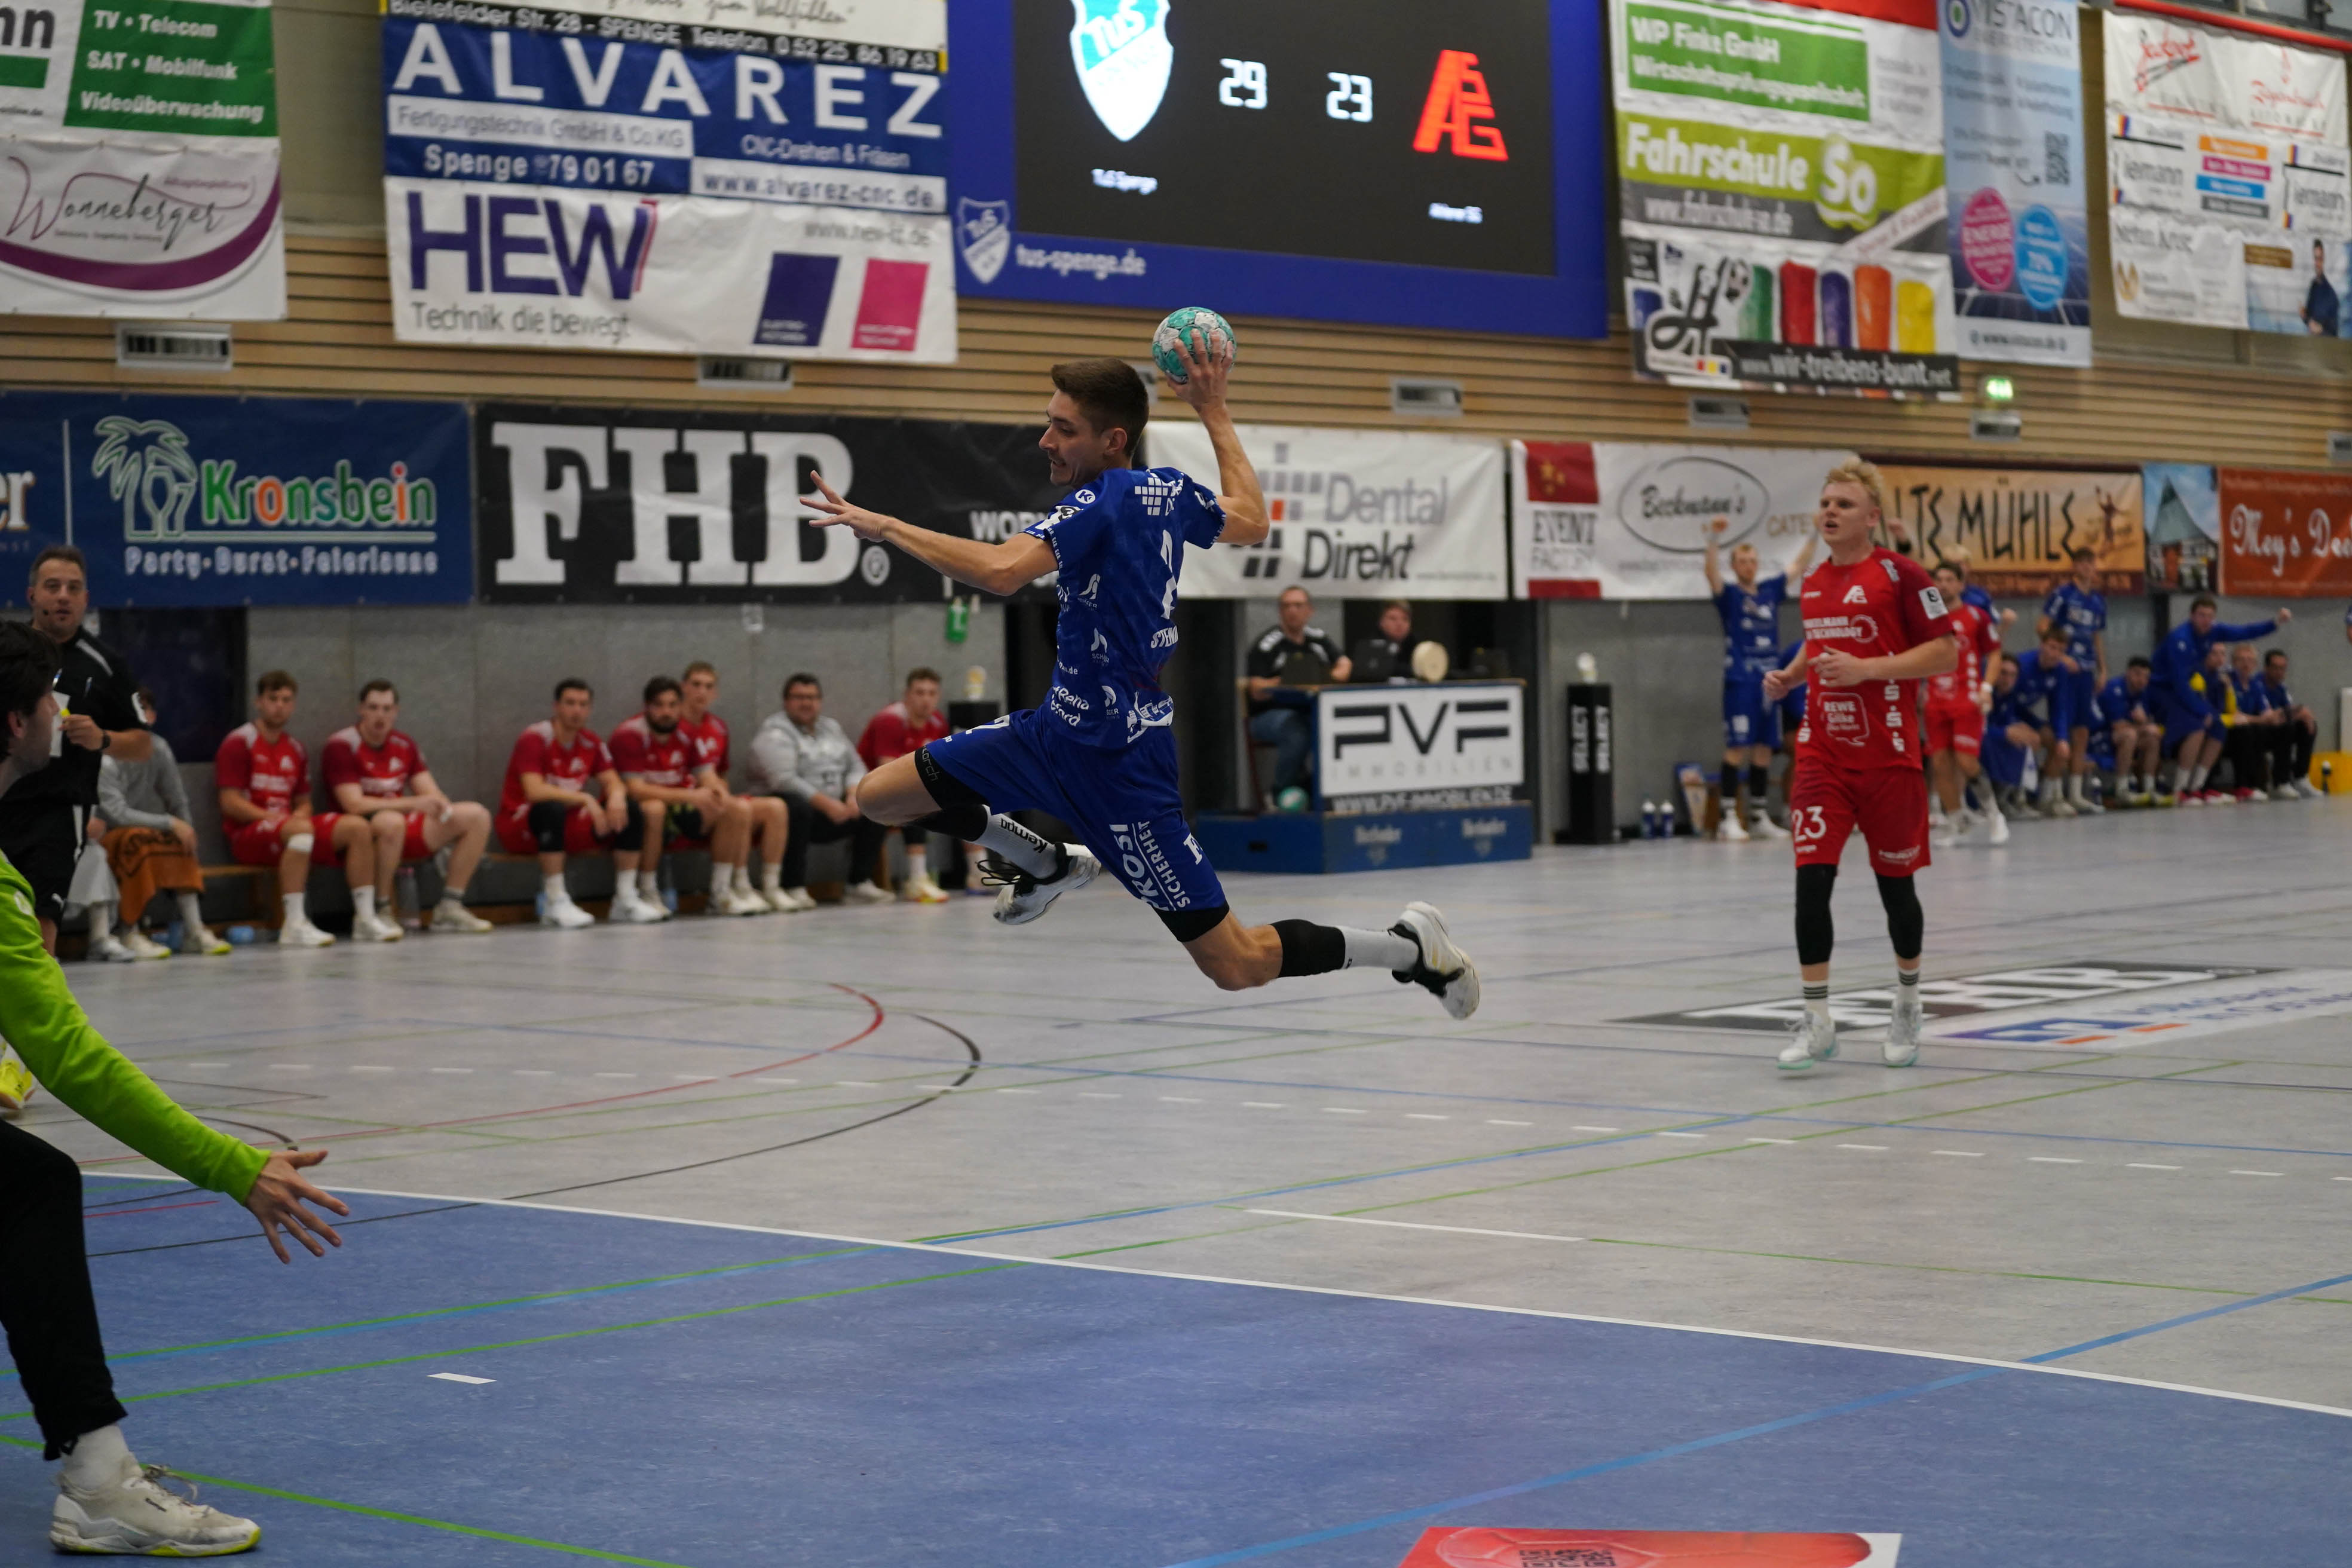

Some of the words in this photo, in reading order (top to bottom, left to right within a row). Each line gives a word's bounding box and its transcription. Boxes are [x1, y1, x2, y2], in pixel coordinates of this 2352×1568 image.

[94, 10, 120, 29] TV
[139, 14, 218, 38] Telecom
[599, 16, 681, 45] SPENGE
[691, 26, 768, 51] Telefon
[1631, 16, 1670, 46] WP
[1724, 31, 1780, 63] GmbH
[88, 50, 127, 69] SAT
[145, 55, 238, 79] Mobilfunk
[393, 23, 942, 138] ALVAREZ
[81, 91, 264, 123] Videoüberwachung
[1220, 58, 1267, 109] 29
[1326, 72, 1373, 122] 23
[550, 118, 608, 143] GmbH
[740, 134, 840, 164] CNC-Drehen
[843, 143, 855, 164] &
[424, 144, 528, 182] Spenge
[1627, 122, 1809, 191] Fahrschule
[1819, 142, 1877, 215] So
[6, 157, 232, 251] Wonneberger
[703, 173, 934, 209] www.alvarez-cnc.de
[408, 191, 651, 299] HEW
[1016, 244, 1147, 280] tus-spenge.de
[412, 302, 505, 333] Technik
[512, 307, 545, 333] die
[550, 308, 632, 345] bewegt
[201, 460, 437, 526] Kronsbein
[491, 421, 860, 586] FHB
[1324, 473, 1447, 525] Dental
[1533, 510, 1598, 543] EVENT
[2230, 503, 2301, 578] May's
[124, 546, 202, 579] Party
[1301, 528, 1414, 581] Direkt
[1334, 700, 1510, 760] PVF
[1000, 817, 1049, 855] Kempa
[1792, 806, 1827, 842] 23
